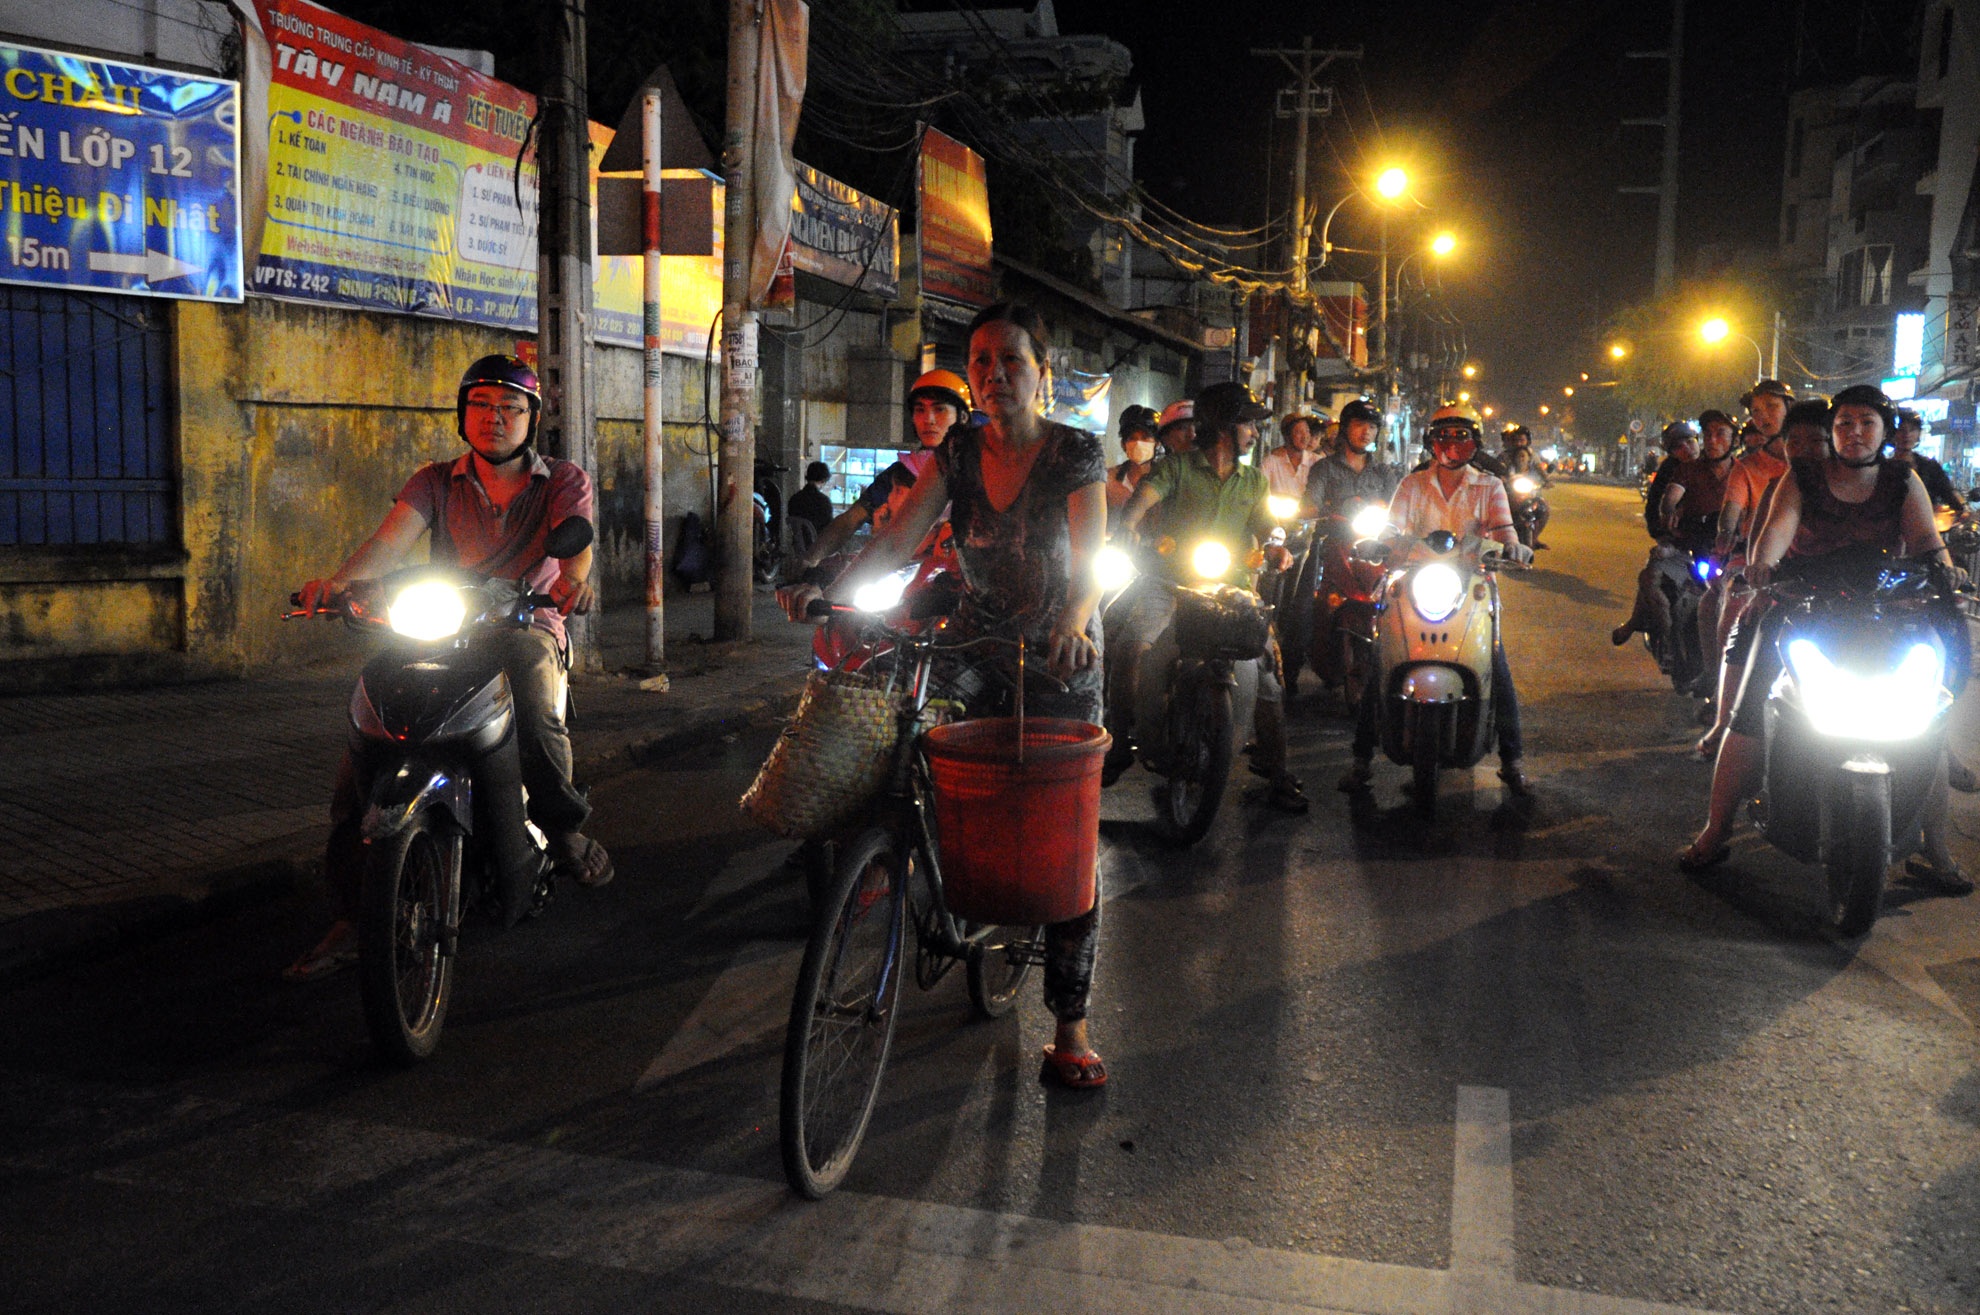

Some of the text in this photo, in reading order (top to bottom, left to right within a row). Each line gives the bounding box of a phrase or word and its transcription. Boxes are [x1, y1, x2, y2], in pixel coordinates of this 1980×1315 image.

[317, 26, 352, 52] TRUNG
[355, 38, 375, 60] CẤP
[377, 50, 400, 70] KINH
[402, 58, 412, 76] TẾ
[276, 42, 452, 124] TÂY NAM Á
[465, 90, 492, 132] XÉT
[59, 127, 135, 170] LỚP
[150, 144, 193, 177] 12
[289, 130, 302, 149] KẾ
[304, 134, 326, 155] TOÁN
[306, 108, 336, 134] CÁC
[339, 118, 384, 148] NGÀNH
[418, 144, 439, 165] TẠO
[276, 162, 285, 176] 2.
[0, 181, 86, 224] Thiệu
[7, 237, 70, 270] 15m
[254, 266, 331, 295] VPTS: 242
